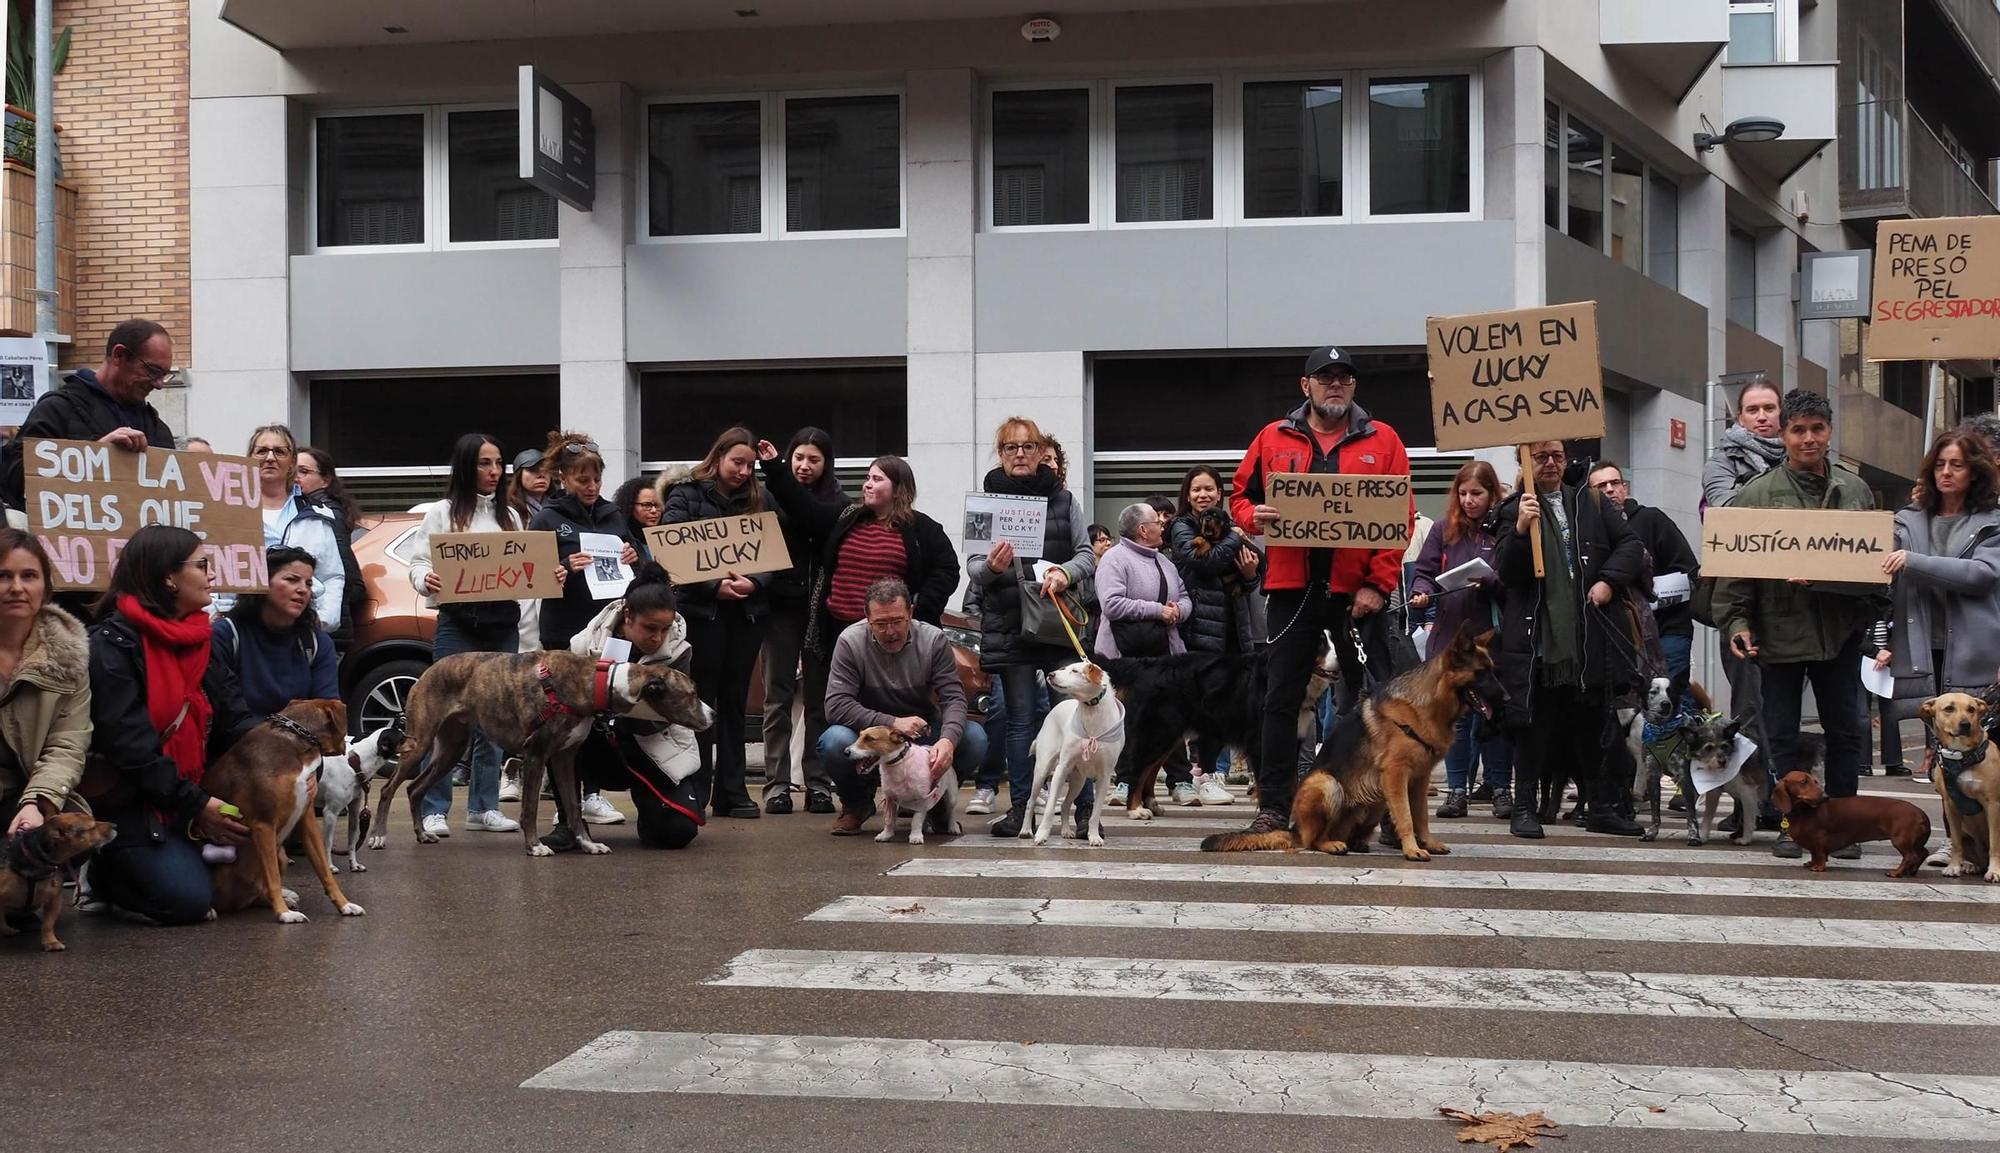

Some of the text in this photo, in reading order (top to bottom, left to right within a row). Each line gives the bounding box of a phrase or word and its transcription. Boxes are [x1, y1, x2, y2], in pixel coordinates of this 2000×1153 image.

[1889, 233, 1972, 254] PENA DE
[1891, 250, 1967, 278] PRESÓ
[1914, 279, 1960, 299] PEL
[1877, 298, 2000, 321] SEGRESTADOR
[1438, 317, 1578, 357] VOLEM EN
[1472, 353, 1551, 388] LUCKY
[1443, 387, 1600, 427] A CASA SEVA
[35, 440, 261, 509] SOM LA VEU
[1272, 476, 1408, 498] PENA DE PRESÓ
[40, 491, 123, 531] DELS
[1323, 500, 1353, 514] PEL
[651, 517, 763, 546] TORNEU EN
[1269, 520, 1409, 542] SEGRESTADOR
[1806, 532, 1884, 555] ANIMAL
[38, 535, 95, 585] NO
[436, 541, 526, 560] TORNEU EN
[696, 539, 762, 572] LUCKY
